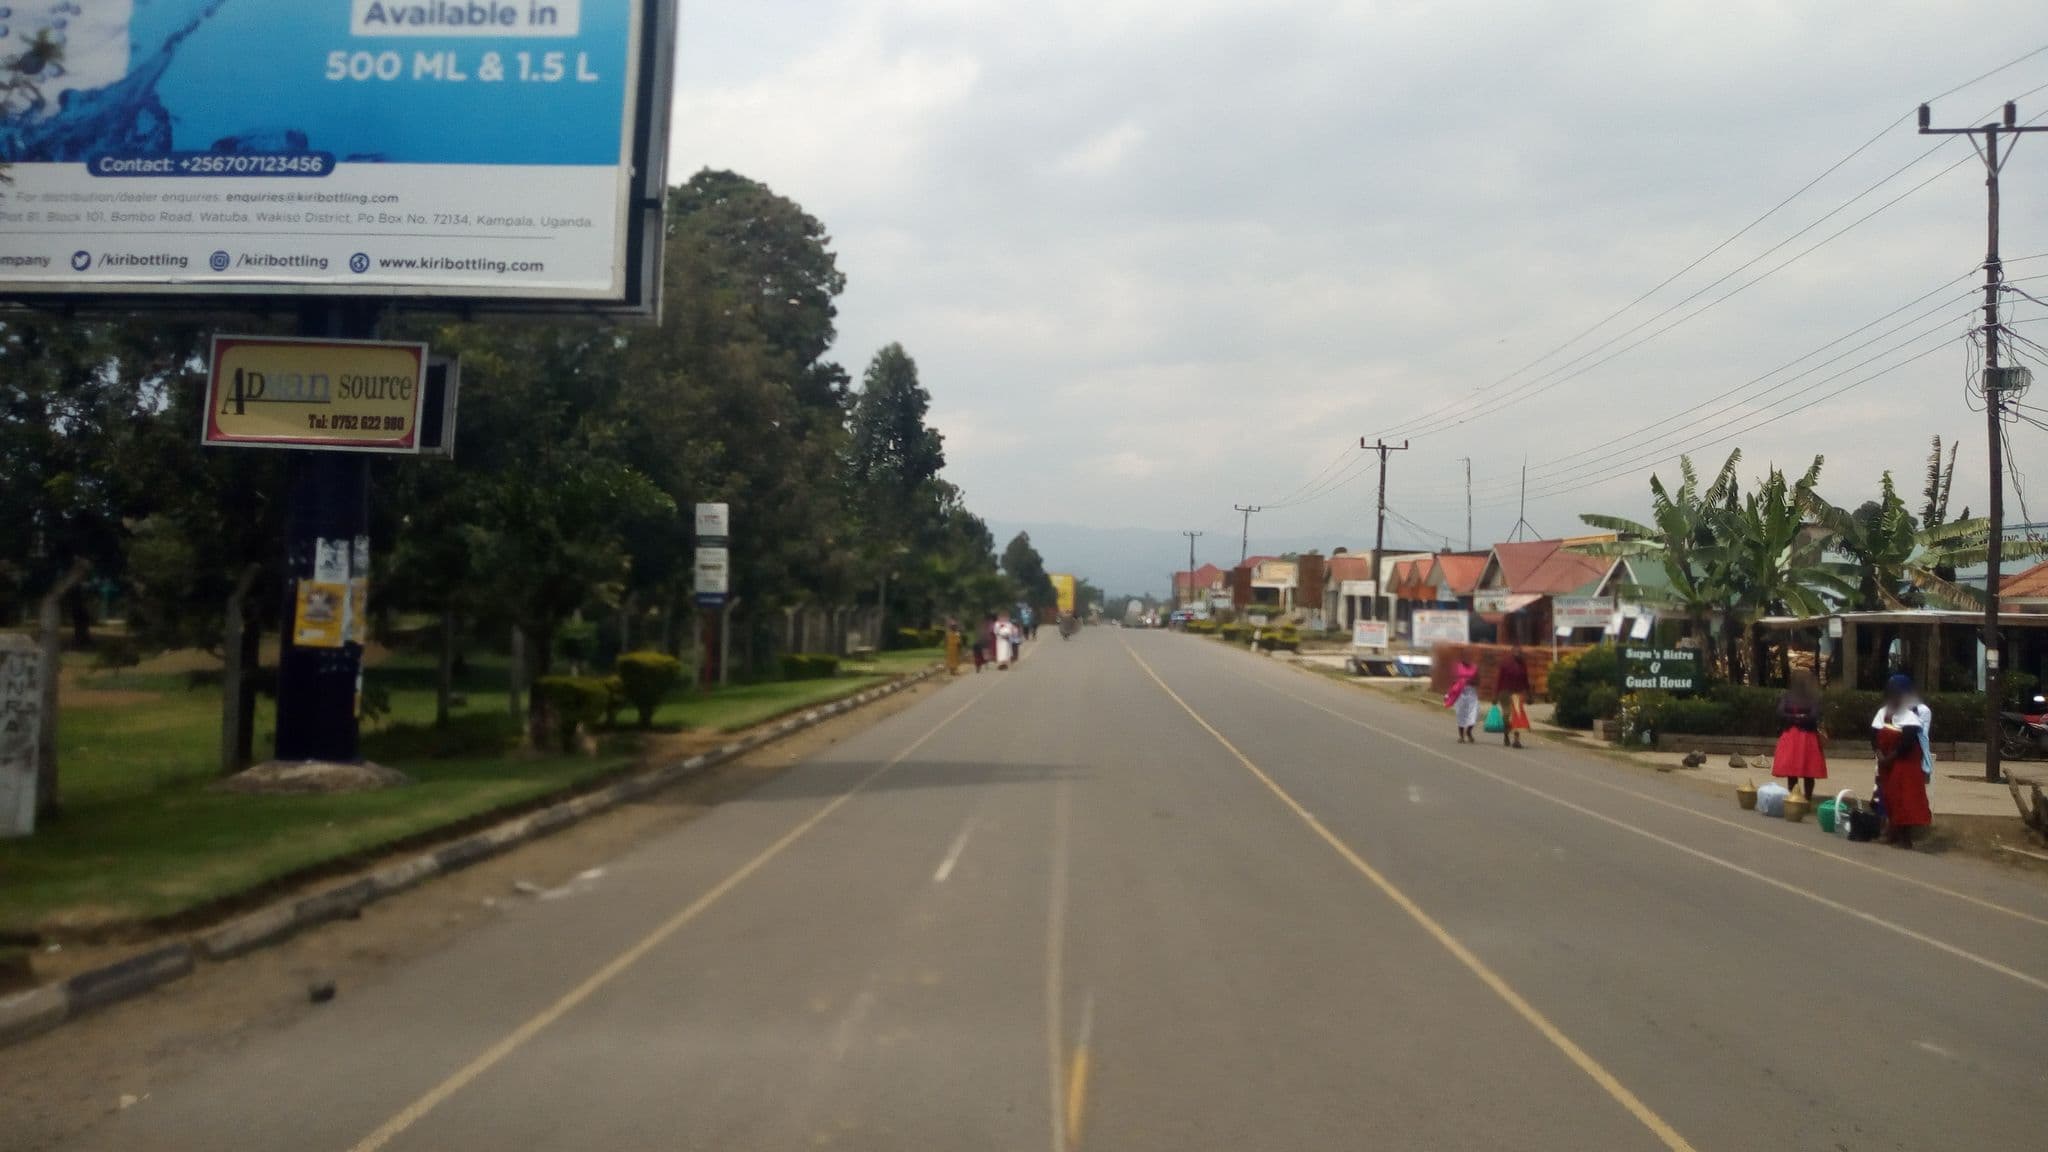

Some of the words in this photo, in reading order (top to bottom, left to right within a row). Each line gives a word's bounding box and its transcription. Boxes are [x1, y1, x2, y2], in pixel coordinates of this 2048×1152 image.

[364, 0, 517, 26] Available
[528, 0, 558, 26] in
[325, 50, 402, 81] 500
[413, 51, 468, 82] ML
[478, 52, 504, 82] &
[516, 52, 566, 82] 1.5
[576, 53, 598, 82] L
[99, 156, 174, 173] Contact:
[180, 156, 323, 173] +256707123456
[226, 191, 399, 206] enquiries@kiribottling.com
[110, 211, 155, 223] Bombo
[378, 214, 402, 225] Box
[0, 255, 51, 268] mpany
[98, 252, 188, 271] /kiribottling
[236, 252, 329, 270] /kiribottling
[379, 254, 544, 273] www.kiribottling.com
[337, 374, 412, 400] source
[331, 415, 358, 430] 0752
[361, 416, 381, 430] 622
[1626, 676, 1657, 688] Guest
[1660, 676, 1692, 688] House
